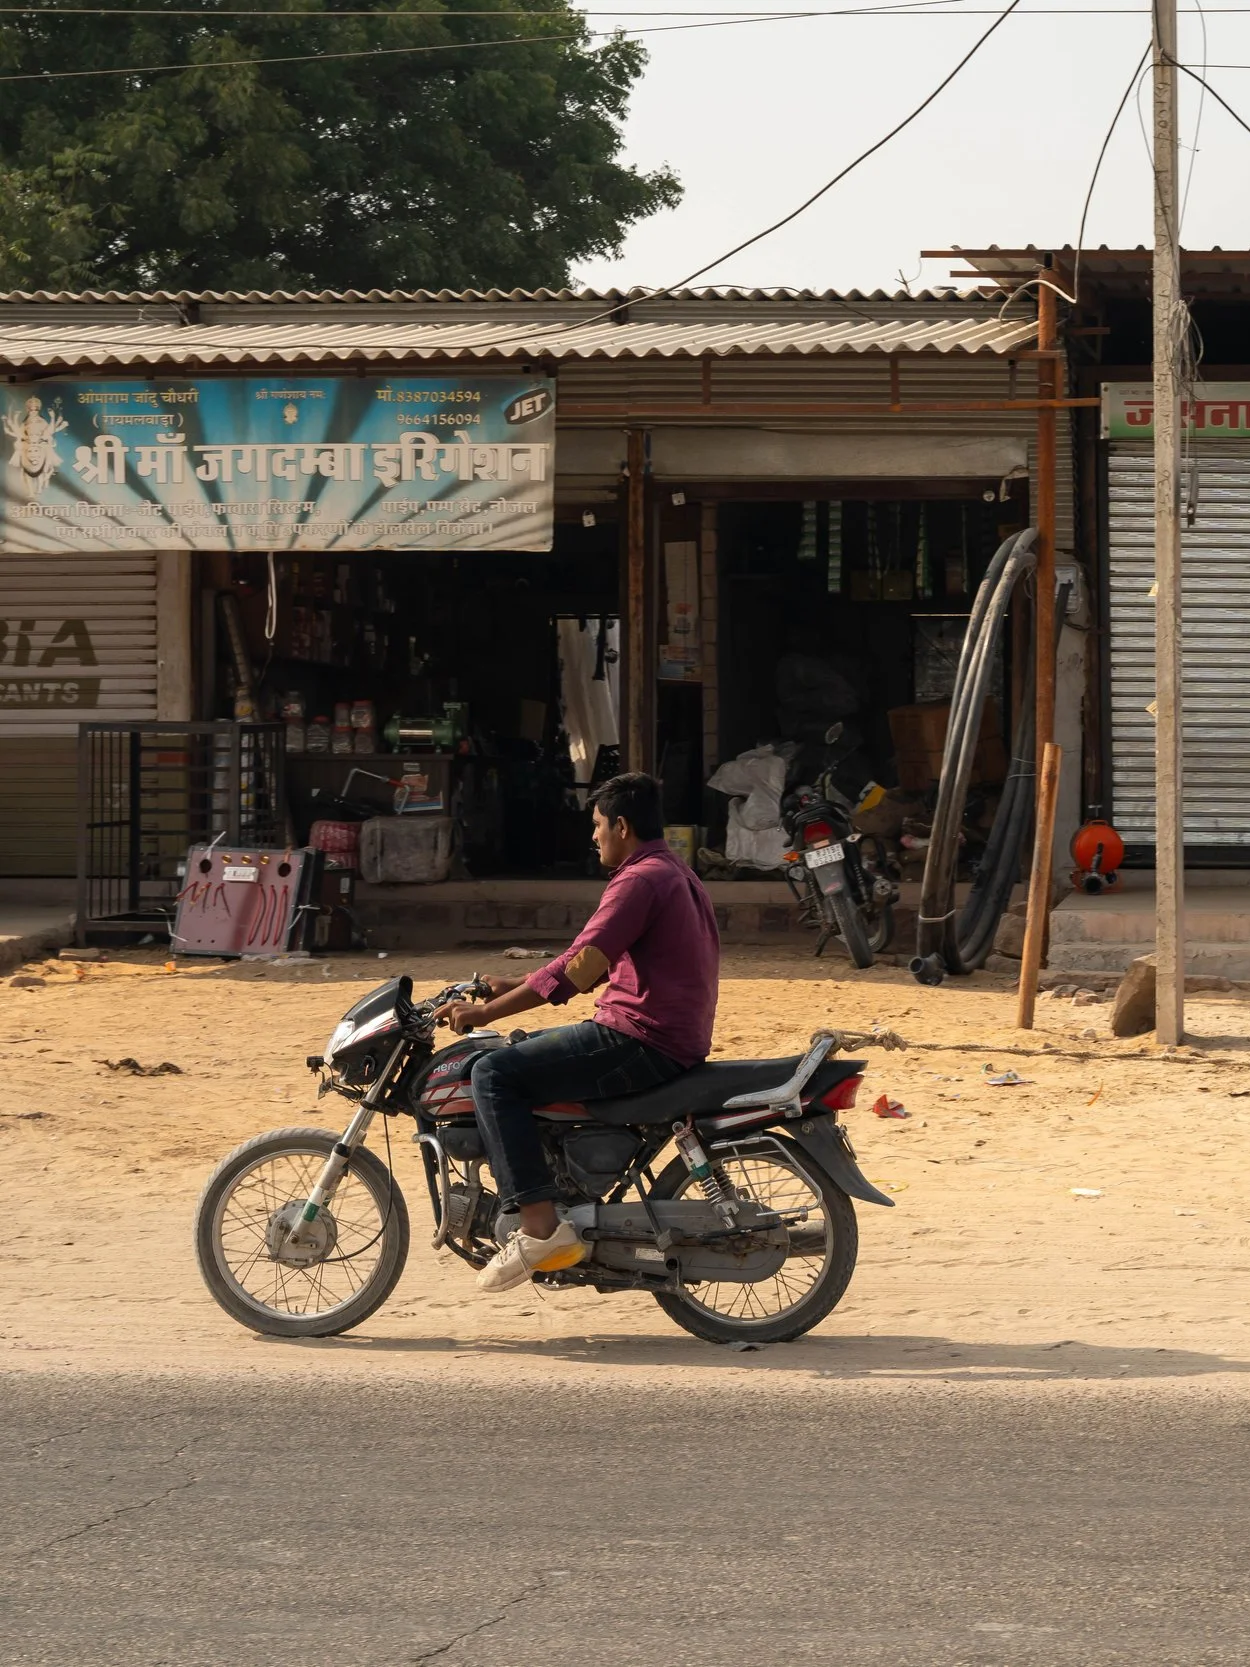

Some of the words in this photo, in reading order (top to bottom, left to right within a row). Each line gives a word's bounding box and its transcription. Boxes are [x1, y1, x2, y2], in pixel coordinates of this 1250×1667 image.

[160, 387, 199, 404] चौधरी
[510, 392, 547, 421] JET
[396, 413, 481, 426] 9664156094
[72, 434, 129, 485] श्री
[193, 442, 369, 484] जगदम्बा
[370, 430, 550, 489] इरिगेशन
[11, 501, 71, 520] अधिकृत
[0, 682, 80, 704] ANTS
